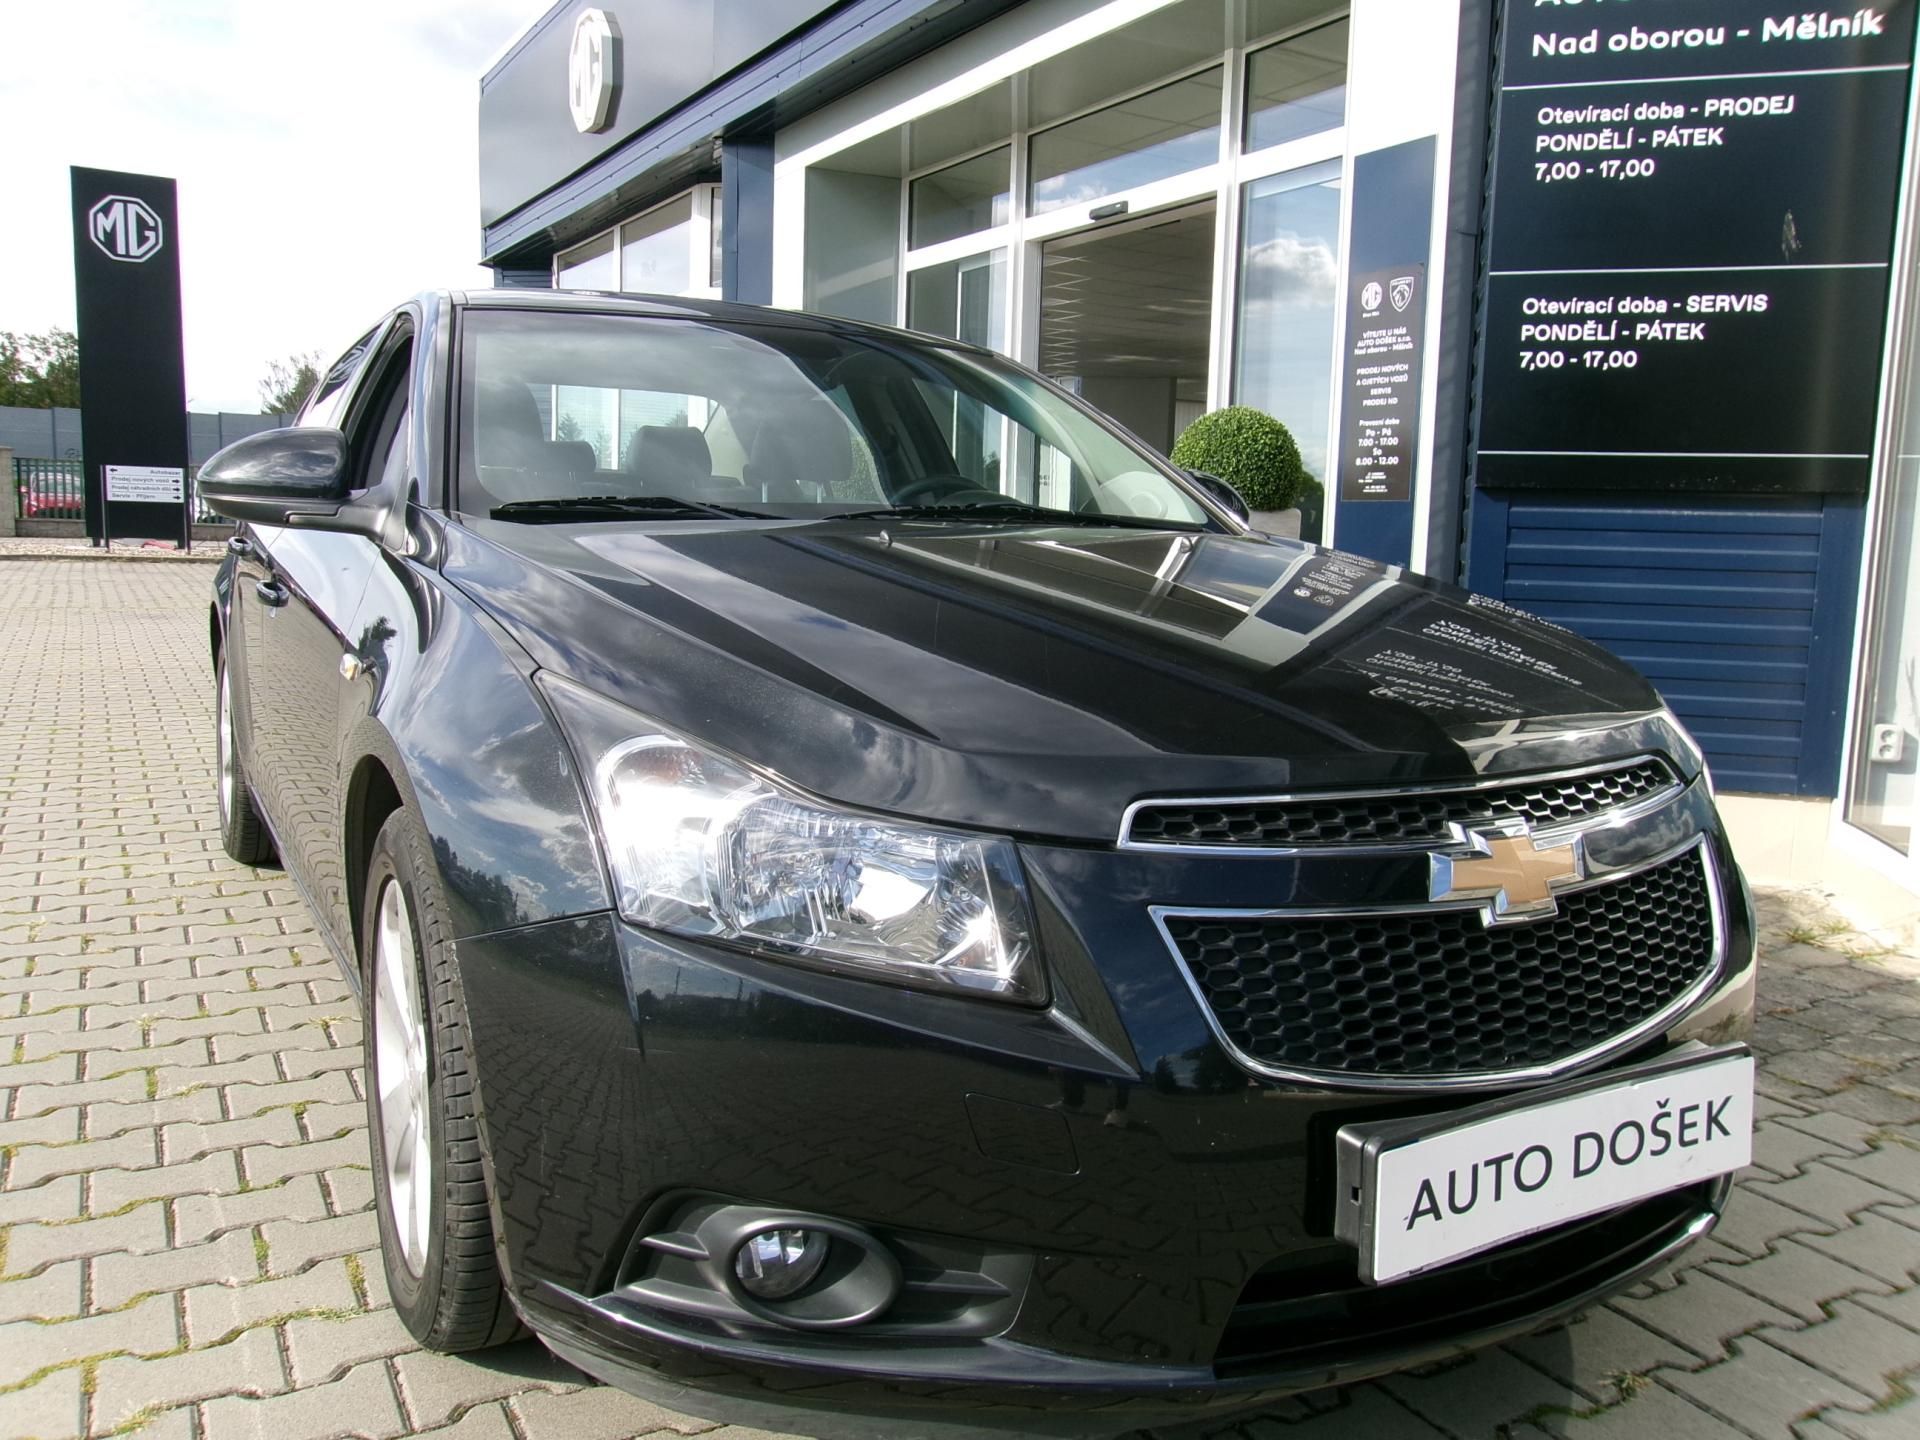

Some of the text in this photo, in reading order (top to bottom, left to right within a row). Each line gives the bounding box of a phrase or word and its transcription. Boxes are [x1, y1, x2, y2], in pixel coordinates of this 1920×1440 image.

[1532, 29, 1598, 56] Nad
[1608, 26, 1725, 52] oborou
[1762, 8, 1885, 43] Mělník
[1537, 103, 1630, 126] Otevírací
[1634, 101, 1685, 121] doba
[1704, 95, 1795, 117] PRODEJ
[1536, 127, 1634, 152] PONDĚLÍ
[1651, 125, 1725, 148] PÁTEK
[1535, 162, 1581, 183] 7,00
[1599, 159, 1656, 181] 17,00
[97, 201, 157, 257] MG
[1522, 296, 1614, 315] Otevírací
[1617, 296, 1668, 314] doba
[1686, 294, 1769, 313] SERVIS
[1356, 338, 1375, 348] AUTO
[1520, 320, 1618, 342] PONDĚLÍ
[1635, 320, 1706, 341] PÁTEK
[1519, 351, 1565, 370] 7,00
[1583, 350, 1638, 371] 17,00
[1405, 1095, 1733, 1231] AUTO DOŠEK
